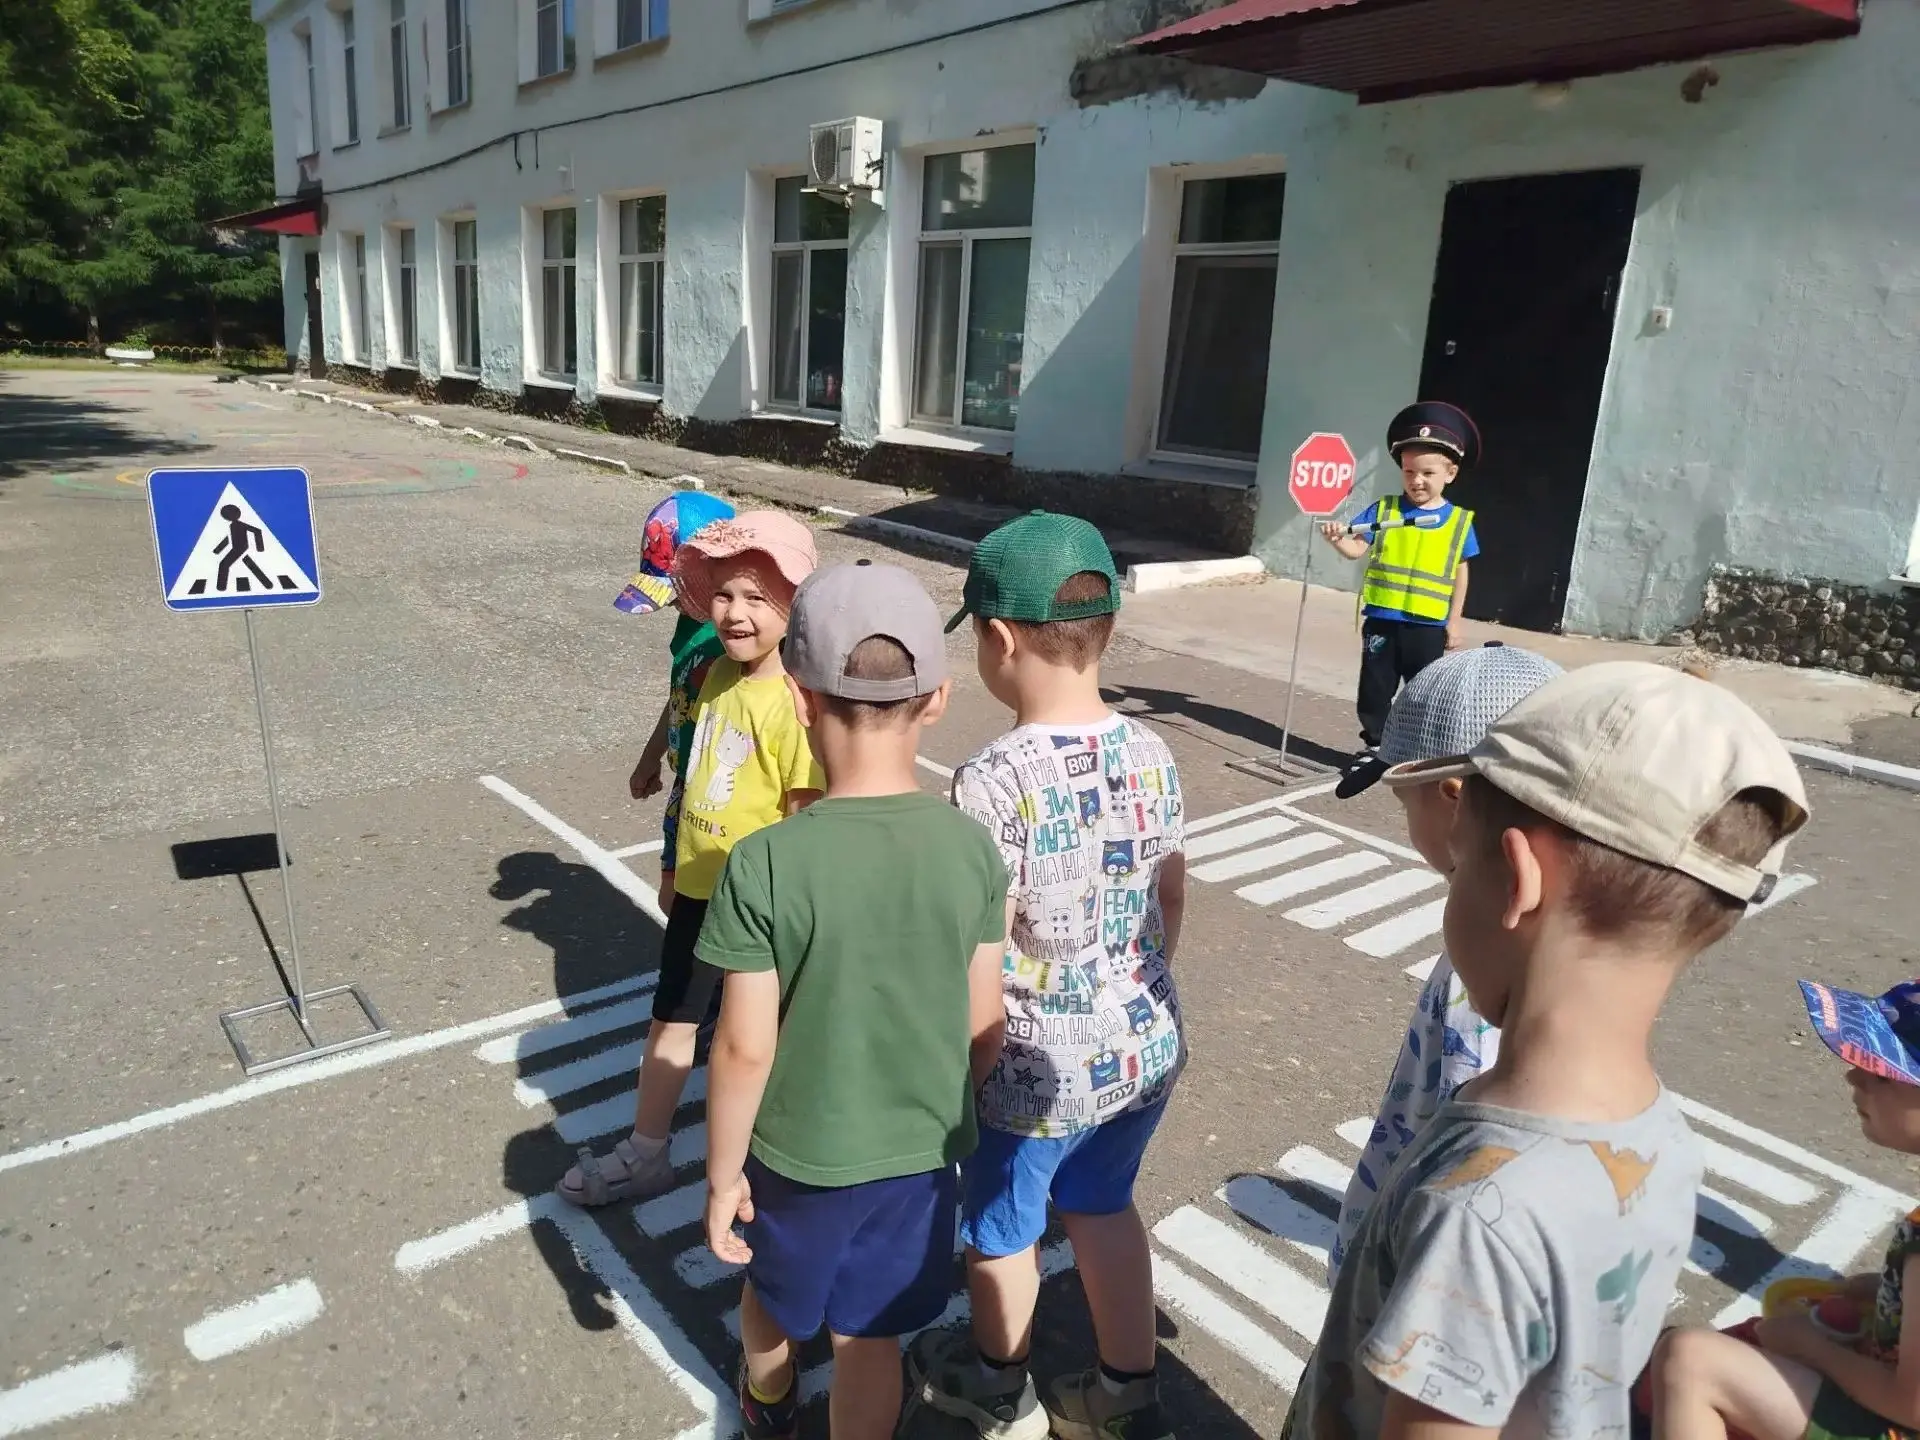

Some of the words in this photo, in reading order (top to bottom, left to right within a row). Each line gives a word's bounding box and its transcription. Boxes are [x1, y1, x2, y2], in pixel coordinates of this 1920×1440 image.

[1294, 460, 1353, 489] STOP
[1066, 754, 1096, 775] BOY
[1031, 857, 1060, 888] HA
[1103, 917, 1134, 945] ME
[1039, 992, 1094, 1015] FEAR
[1039, 1018, 1066, 1045] HA
[1098, 1083, 1134, 1108] BOY
